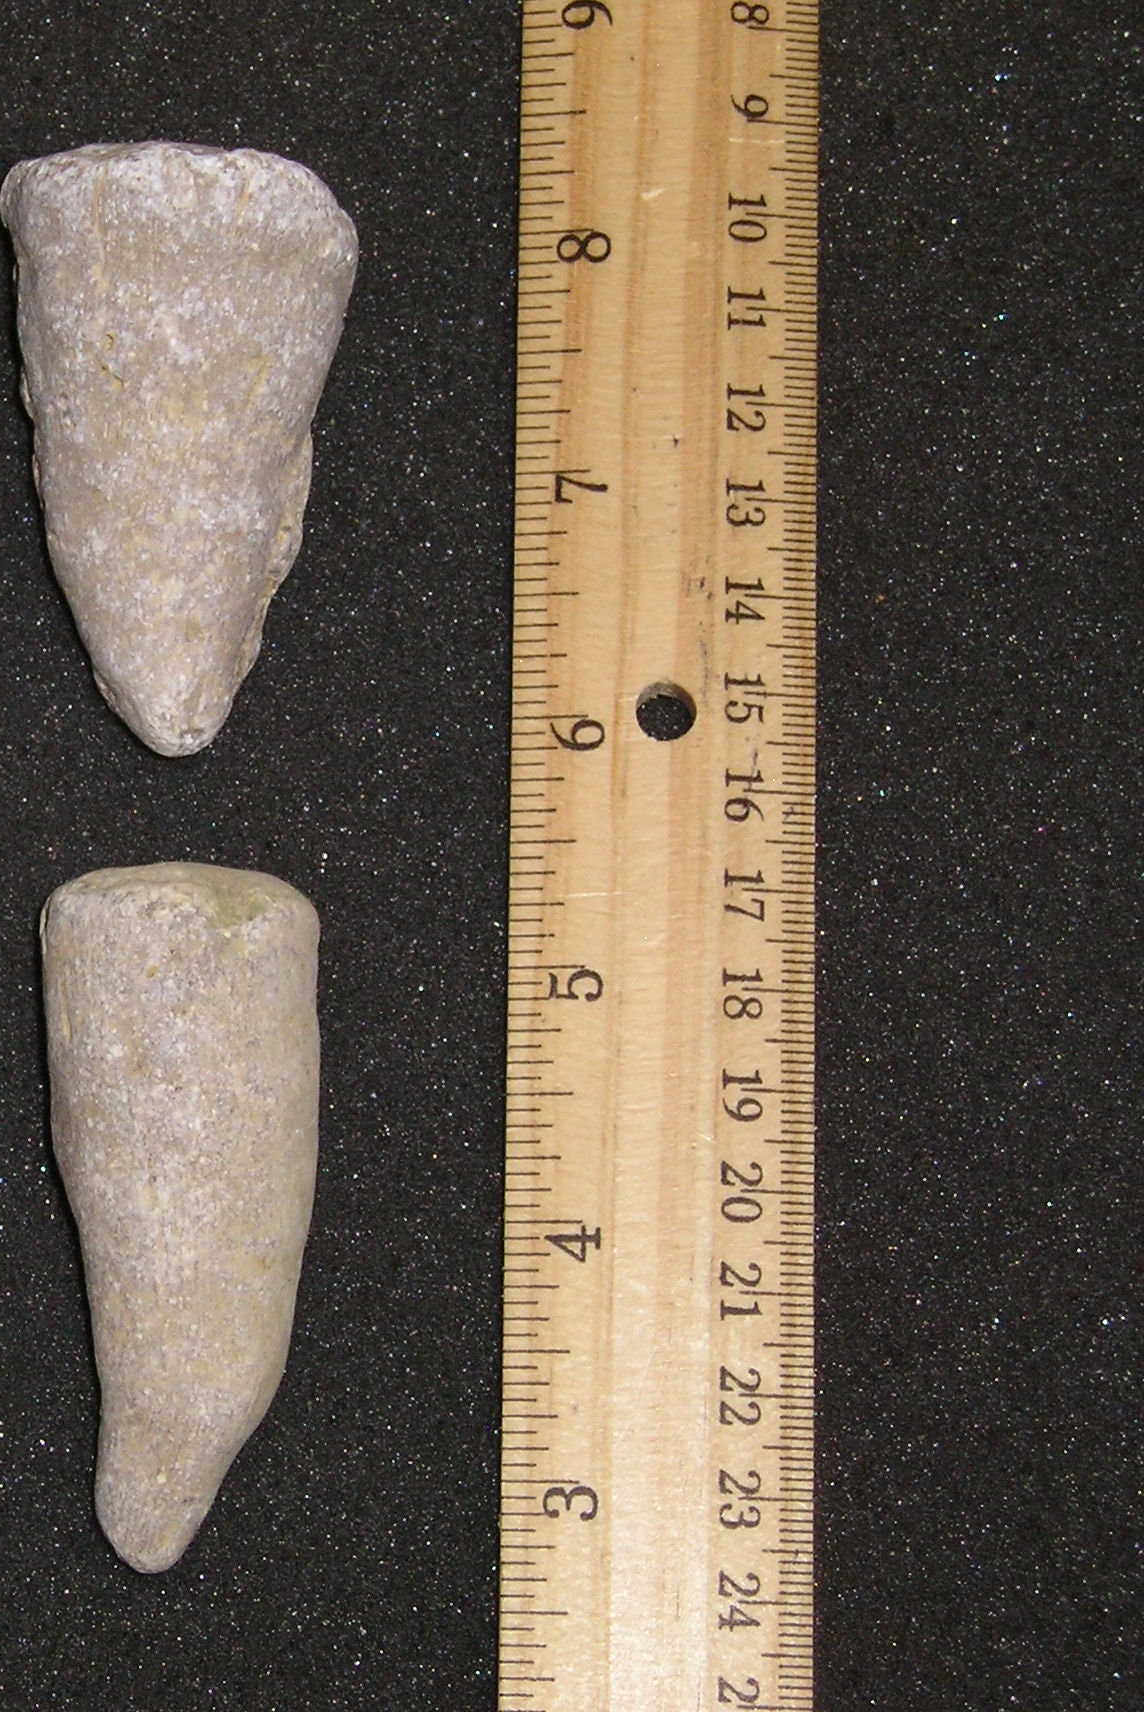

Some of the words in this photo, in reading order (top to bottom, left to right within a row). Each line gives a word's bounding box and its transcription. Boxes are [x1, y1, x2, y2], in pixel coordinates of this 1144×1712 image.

[561, 0, 613, 30] 9
[731, 0, 769, 26] 8
[731, 94, 769, 119] 9
[728, 192, 768, 243] 10
[557, 231, 611, 263] 8
[727, 286, 767, 331] 11
[726, 383, 767, 432] 12
[555, 473, 608, 504] 7
[725, 478, 766, 528] 13
[725, 576, 765, 625] 14
[724, 672, 765, 725] 15
[550, 718, 606, 752] 6
[724, 768, 765, 823] 16
[724, 868, 766, 922] 17
[548, 968, 604, 1003] 5
[722, 967, 764, 1021] 18
[722, 1068, 764, 1123] 19
[720, 1160, 764, 1224] 20
[544, 1225, 602, 1263] 4
[719, 1261, 763, 1321] 21
[719, 1366, 762, 1426] 22
[542, 1484, 599, 1522] 3
[718, 1468, 762, 1530] 23
[718, 1570, 761, 1632] 24
